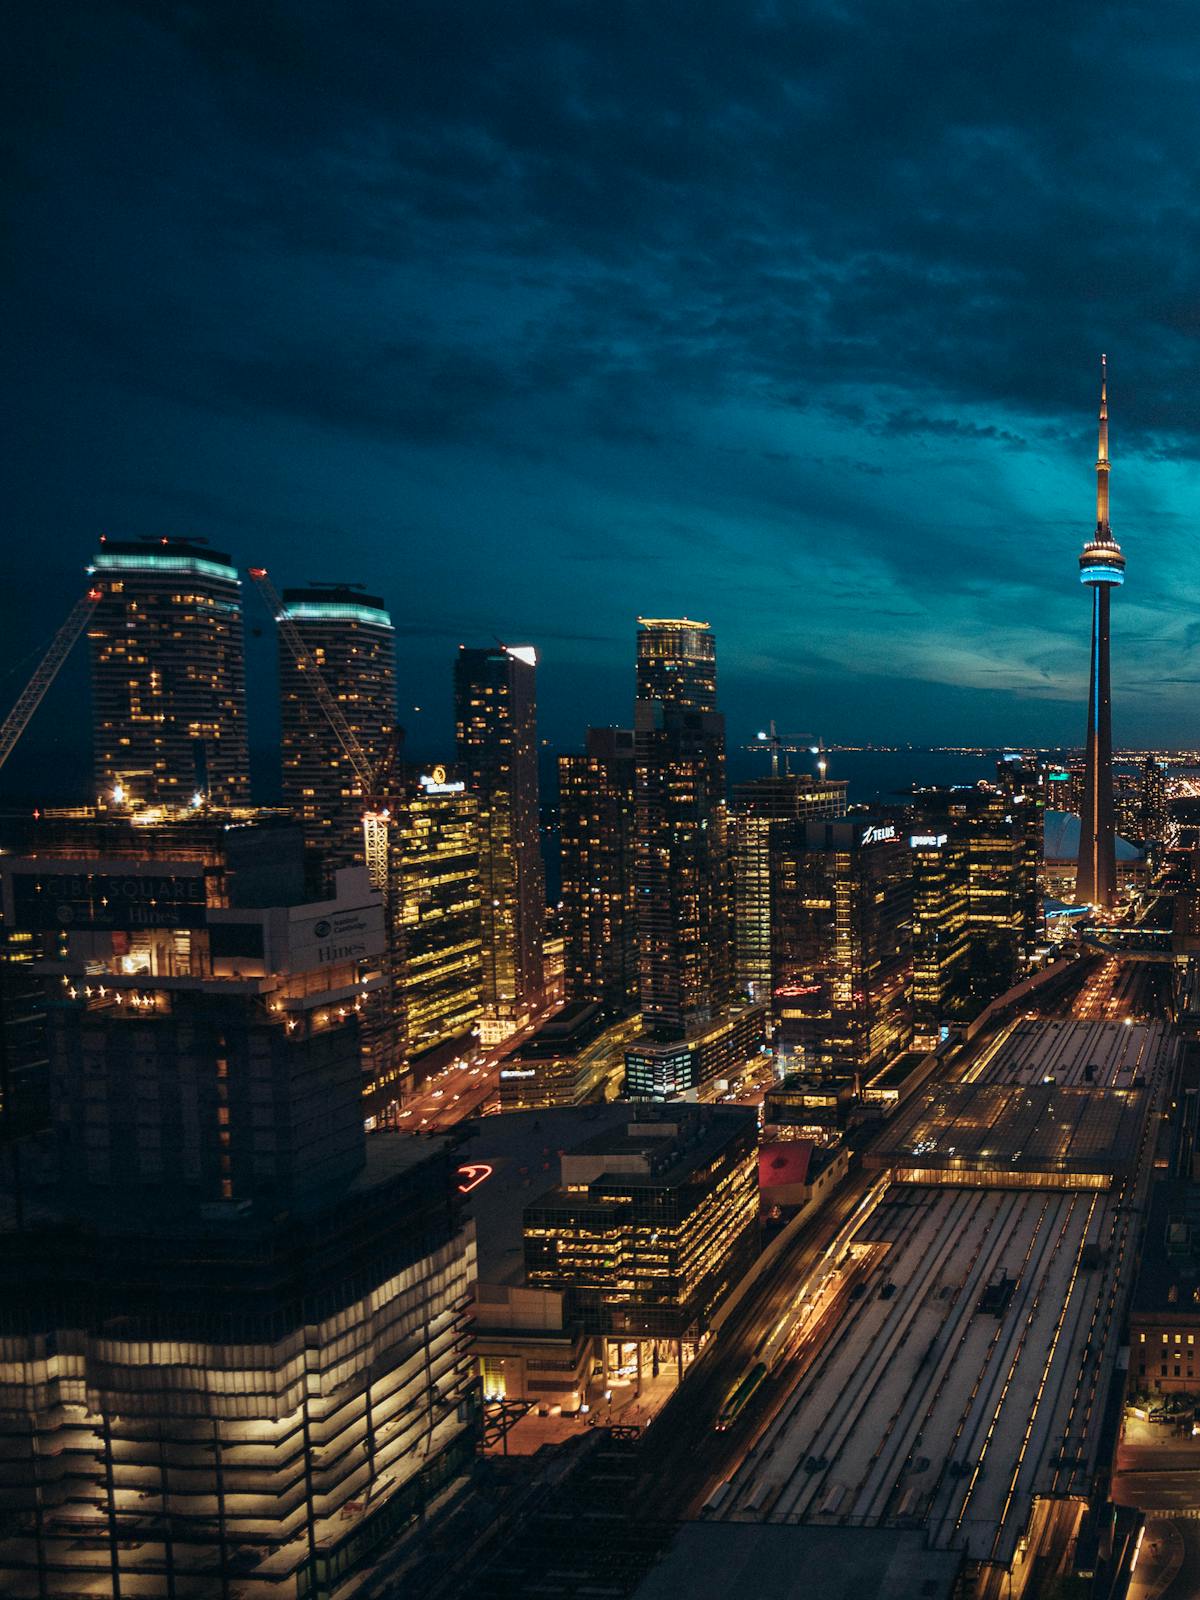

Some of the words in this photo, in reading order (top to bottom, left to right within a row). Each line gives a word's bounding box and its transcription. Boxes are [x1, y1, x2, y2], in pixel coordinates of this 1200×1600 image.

[873, 826, 895, 841] TELUS
[109, 880, 199, 900] SQUARE
[129, 906, 180, 923] Hines
